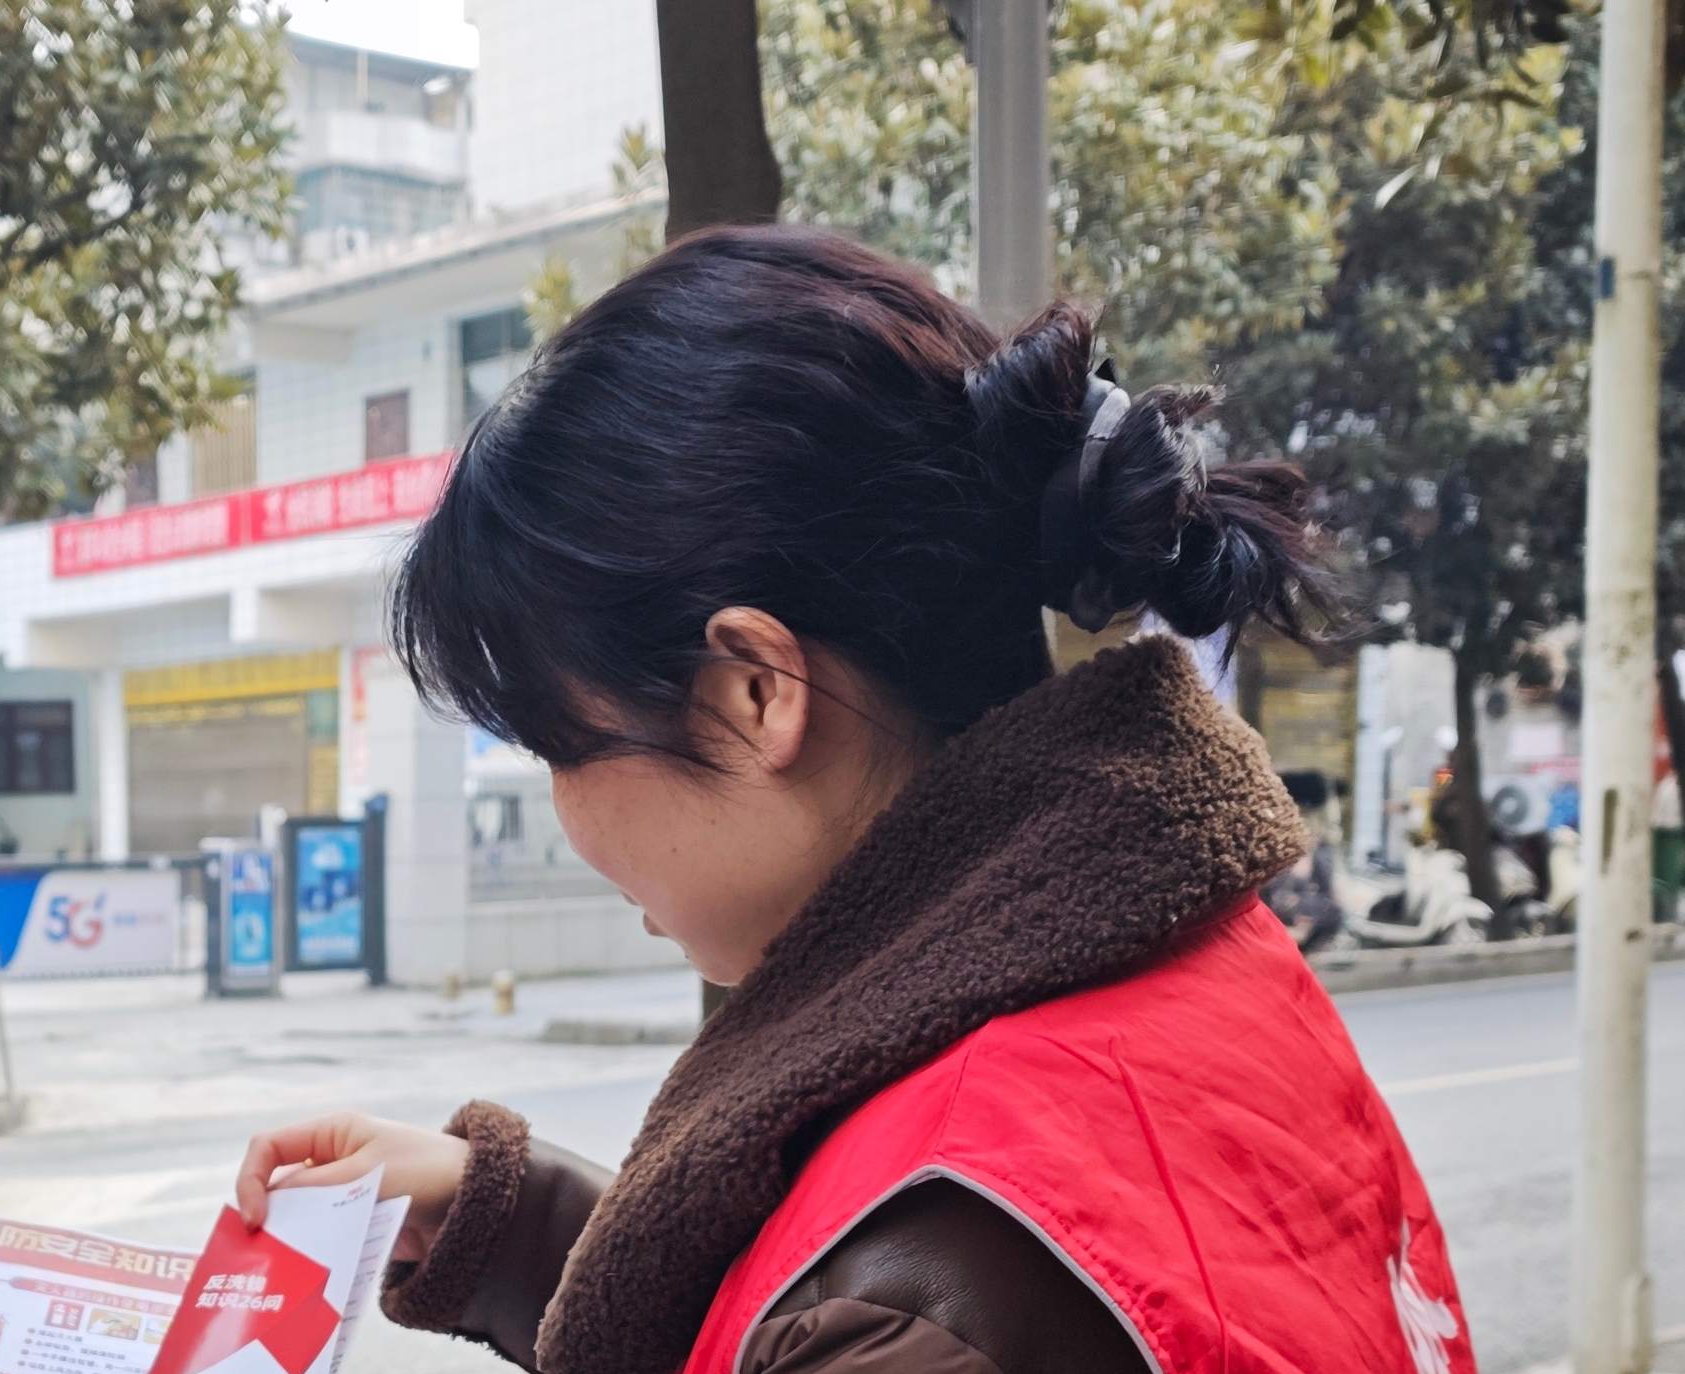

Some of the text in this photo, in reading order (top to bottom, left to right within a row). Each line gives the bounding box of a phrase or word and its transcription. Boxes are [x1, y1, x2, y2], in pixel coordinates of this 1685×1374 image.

[44, 892, 105, 949] 5G
[195, 1292, 284, 1311] 知识26问
